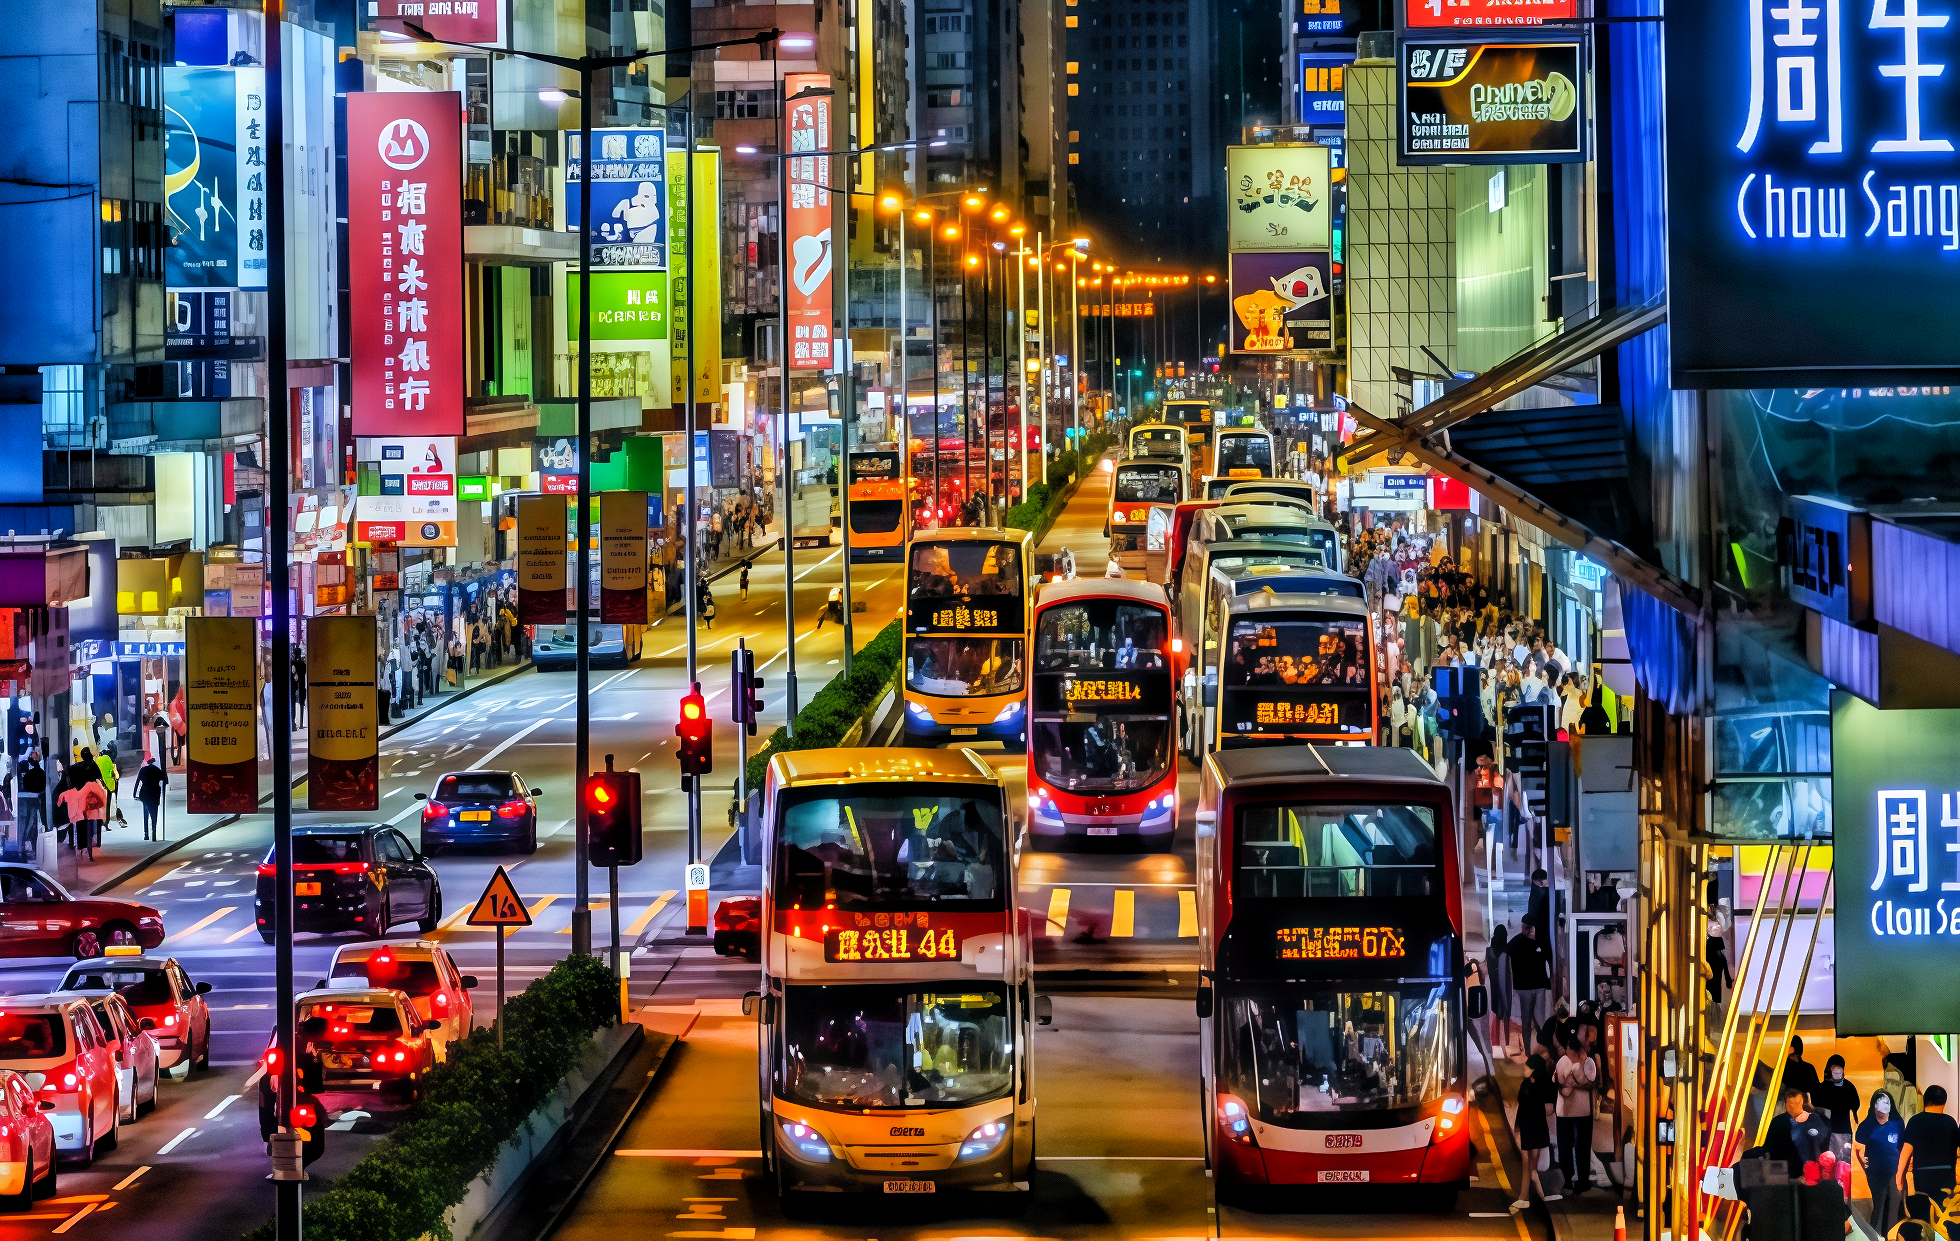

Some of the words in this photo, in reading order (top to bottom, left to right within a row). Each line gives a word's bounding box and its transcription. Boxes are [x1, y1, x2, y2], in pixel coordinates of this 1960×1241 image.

[1736, 0, 1955, 153] 周生
[1737, 173, 1846, 238] Chow
[1862, 170, 1960, 250] Sang
